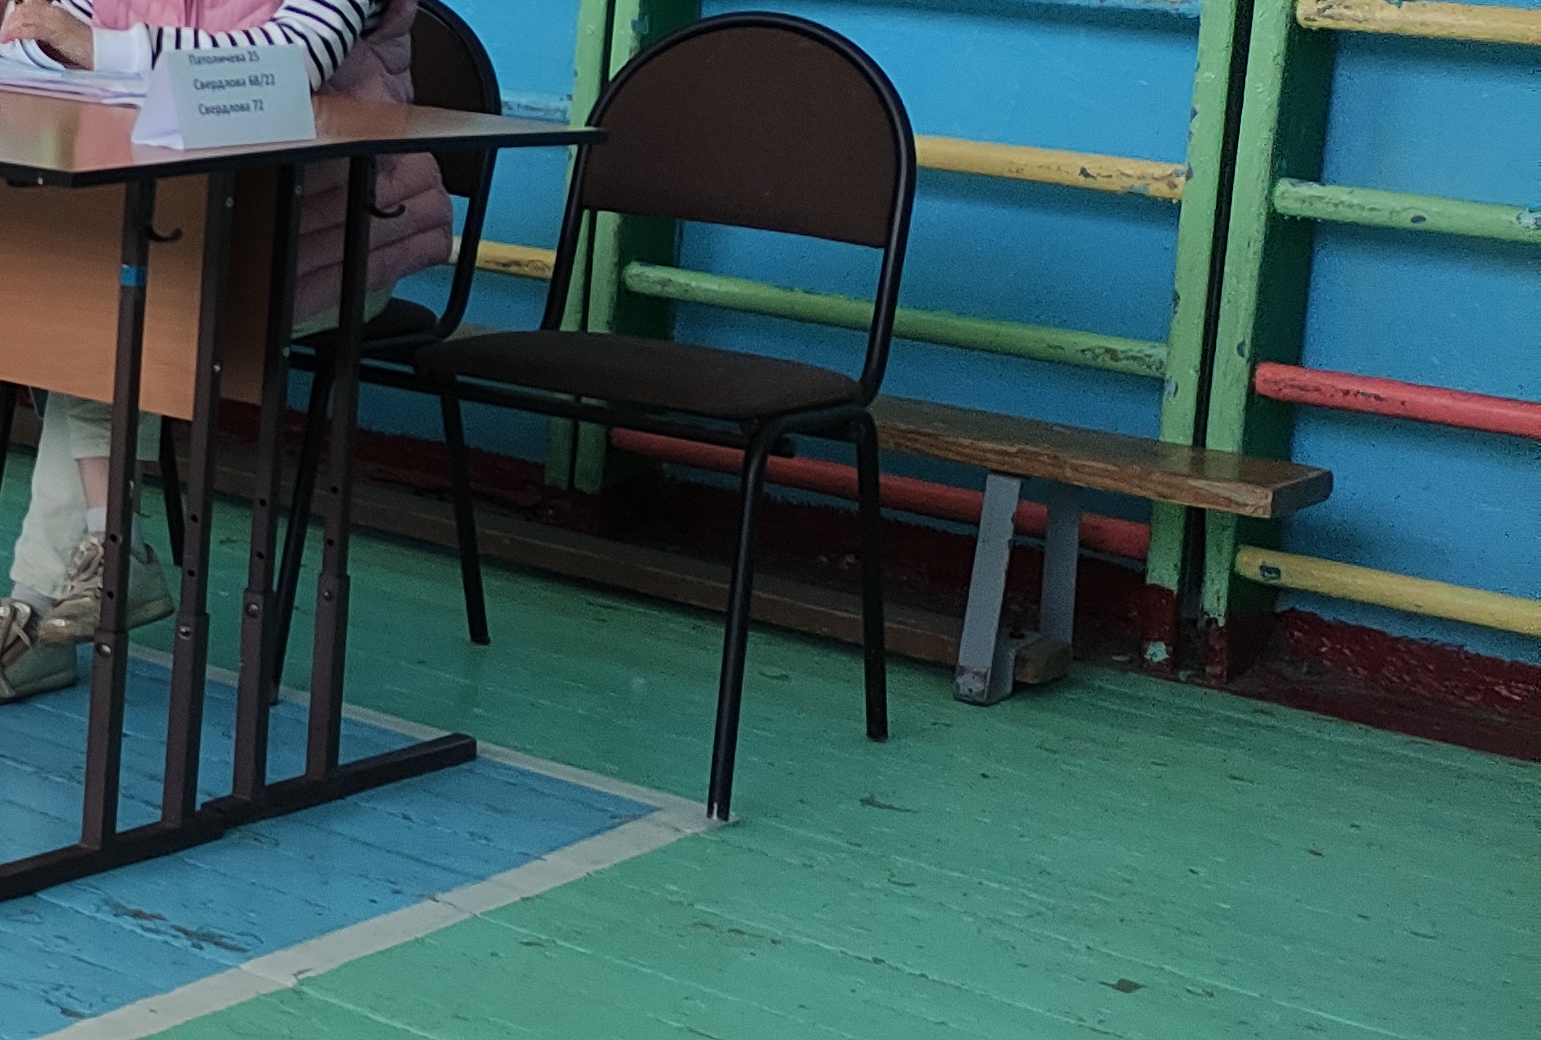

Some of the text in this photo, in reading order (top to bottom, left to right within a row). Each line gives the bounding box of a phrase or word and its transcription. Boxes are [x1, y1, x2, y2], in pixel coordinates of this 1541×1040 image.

[247, 50, 260, 62] 25
[194, 73, 275, 91] Свердлова 68/22
[198, 99, 264, 115] Свердлова 72
